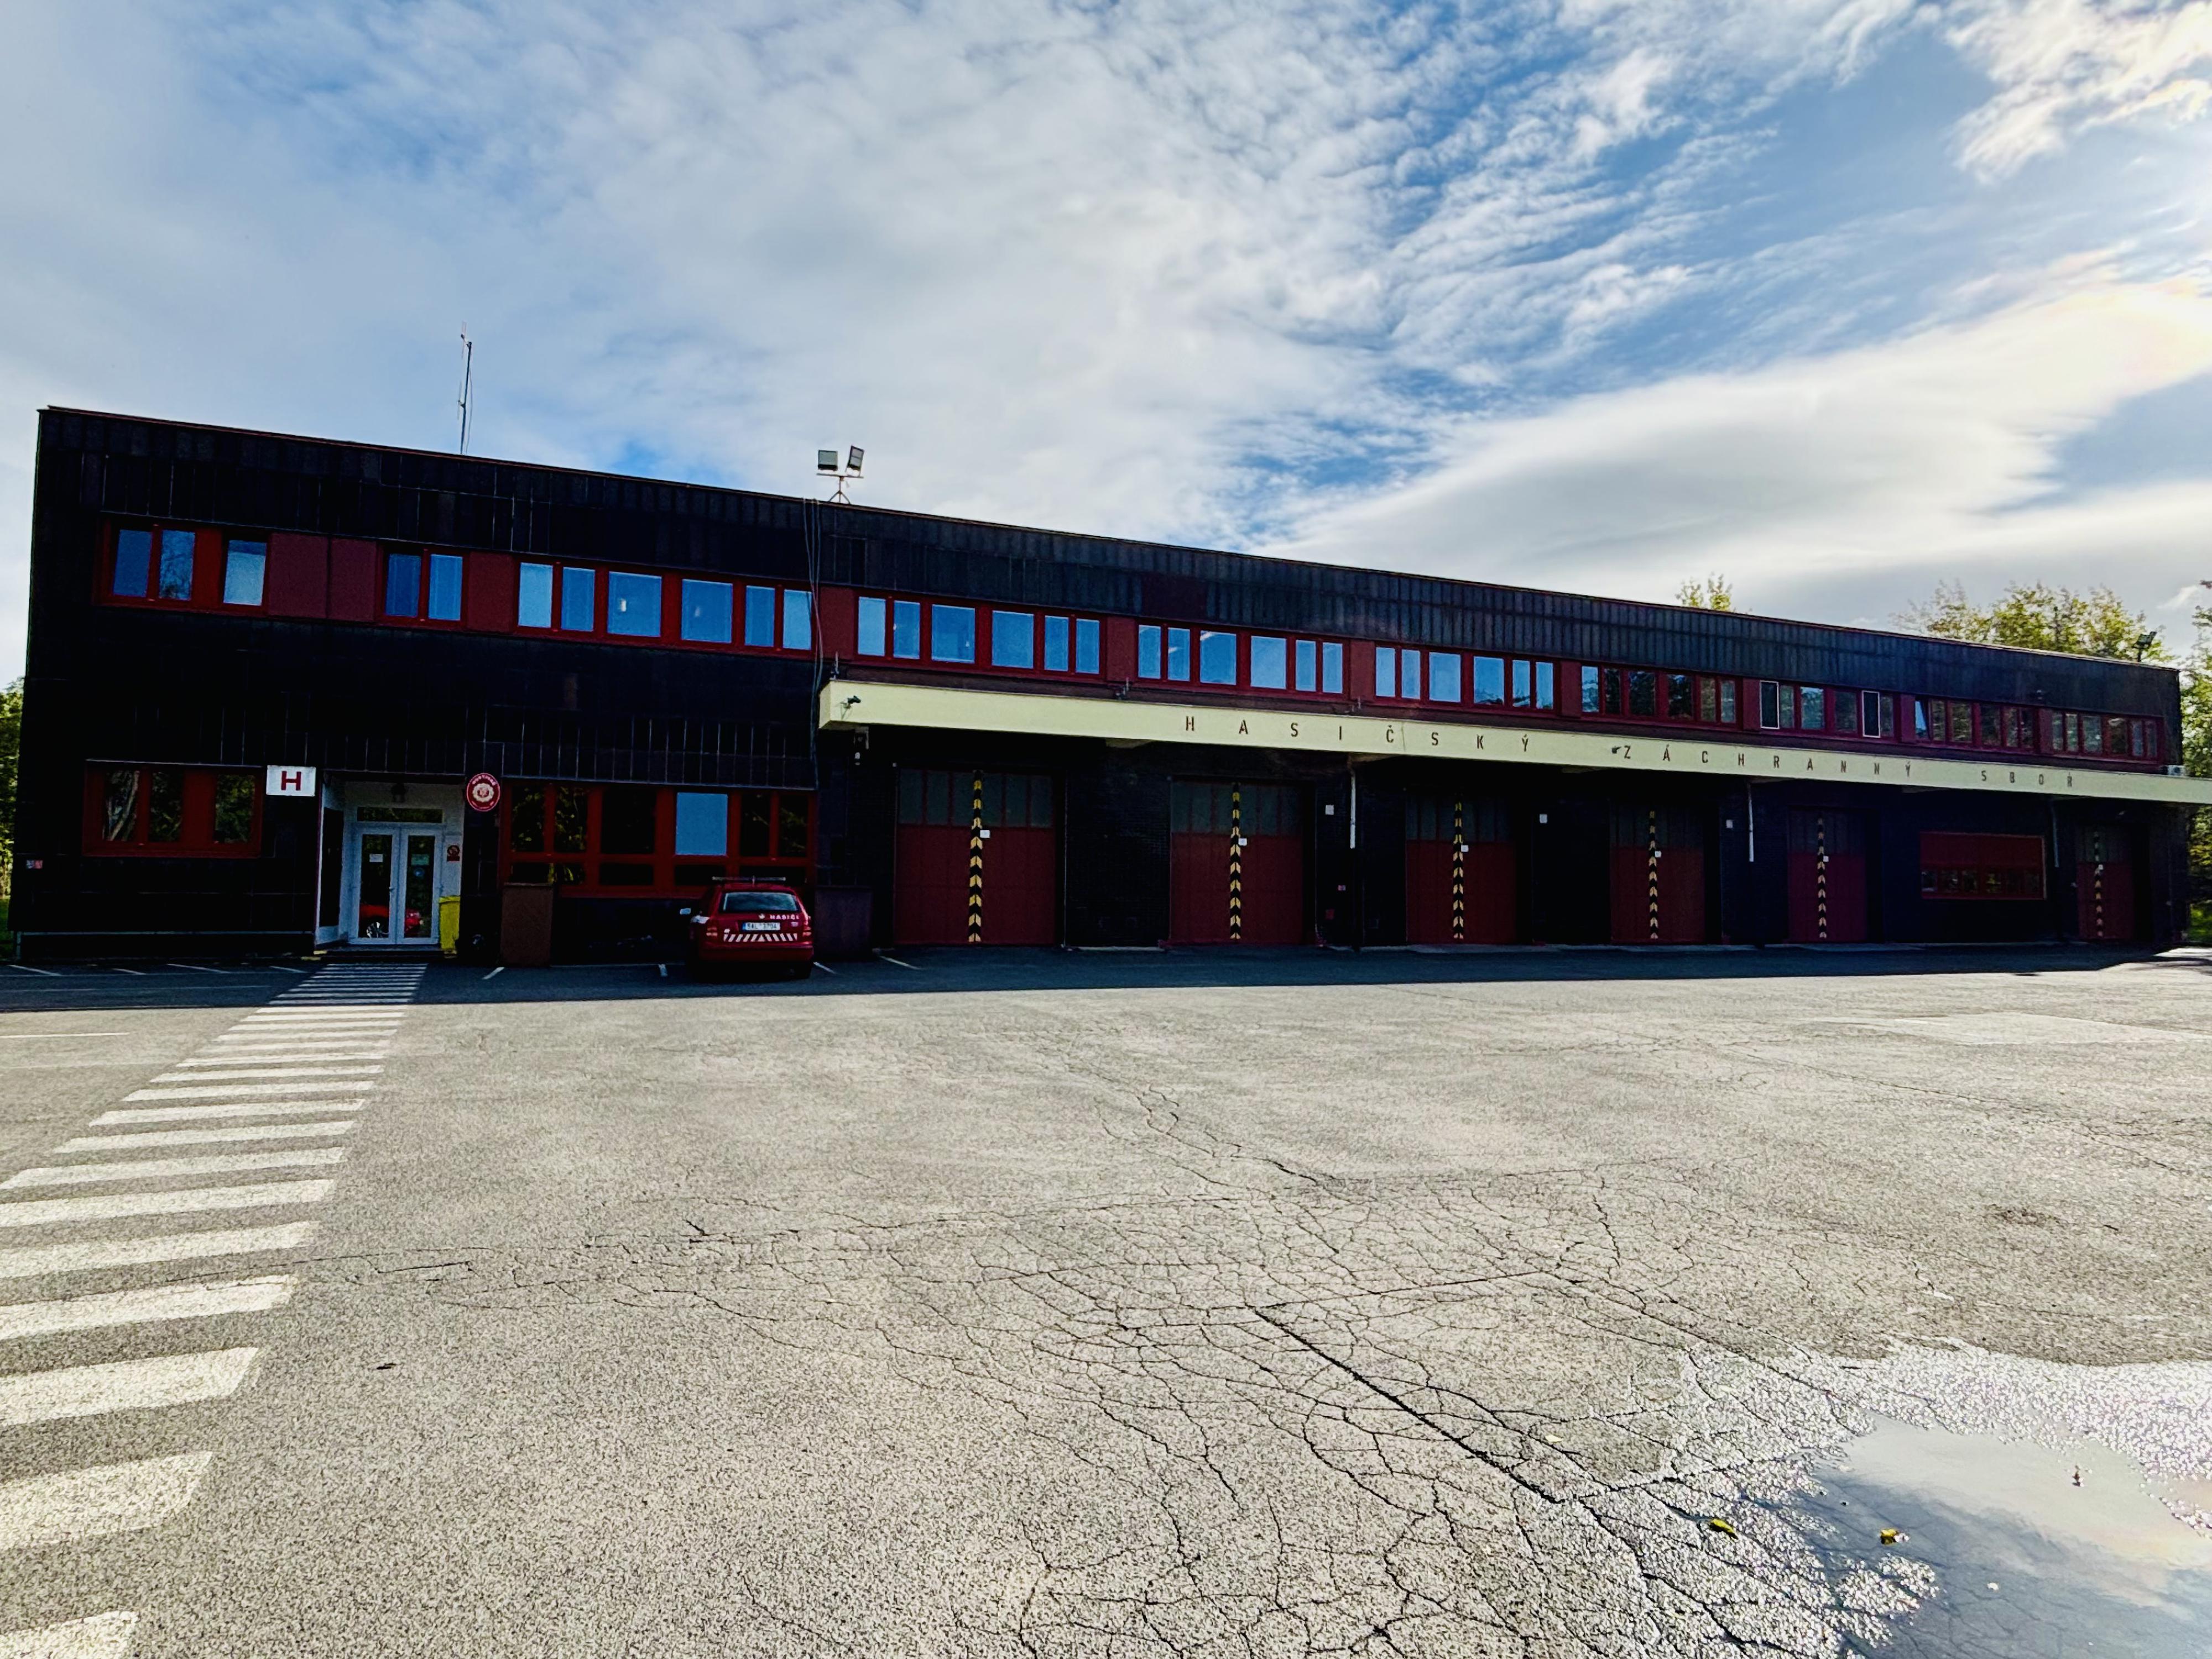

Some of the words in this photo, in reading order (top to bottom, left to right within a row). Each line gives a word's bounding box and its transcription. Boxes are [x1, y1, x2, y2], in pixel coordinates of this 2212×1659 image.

[1185, 716, 1529, 752] HASIČSKÝ
[1624, 744, 1911, 778] ZÁCHRANNÝ
[281, 770, 302, 791] H
